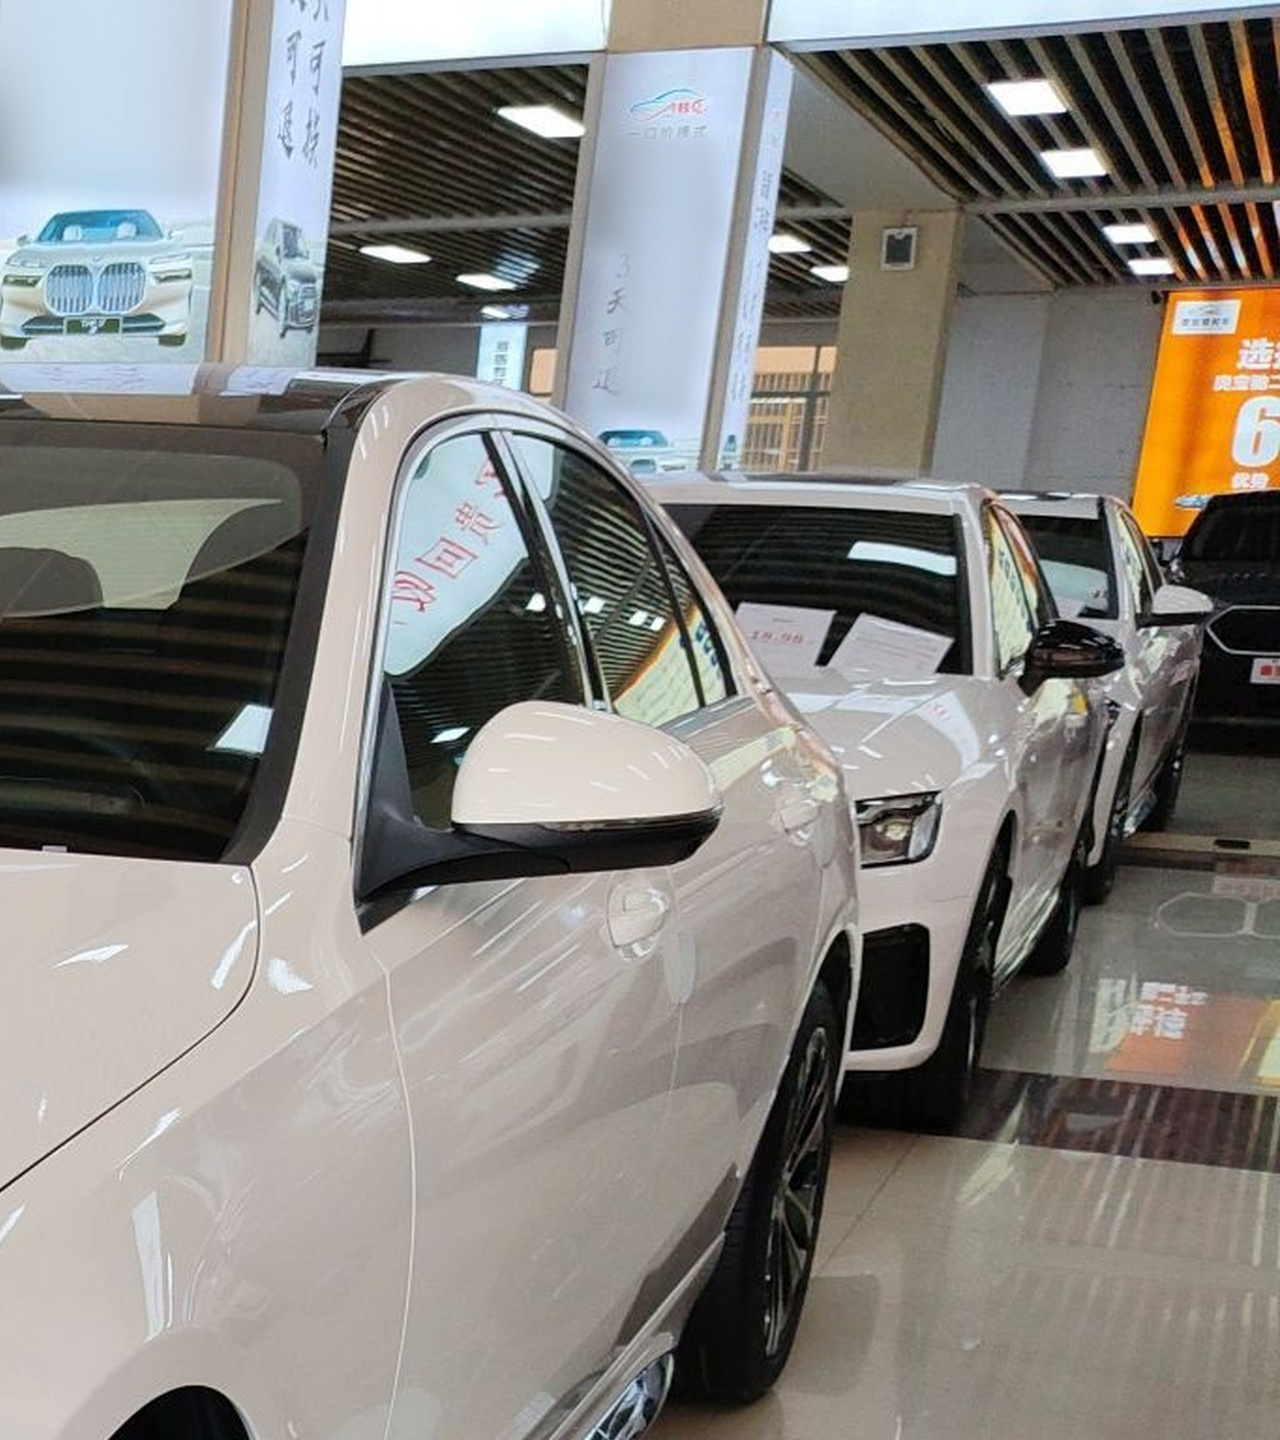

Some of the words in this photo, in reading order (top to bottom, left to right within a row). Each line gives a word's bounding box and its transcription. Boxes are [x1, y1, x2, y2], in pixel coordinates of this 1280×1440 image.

[627, 125, 707, 139] 一口价模式
[1236, 337, 1280, 371] 选
